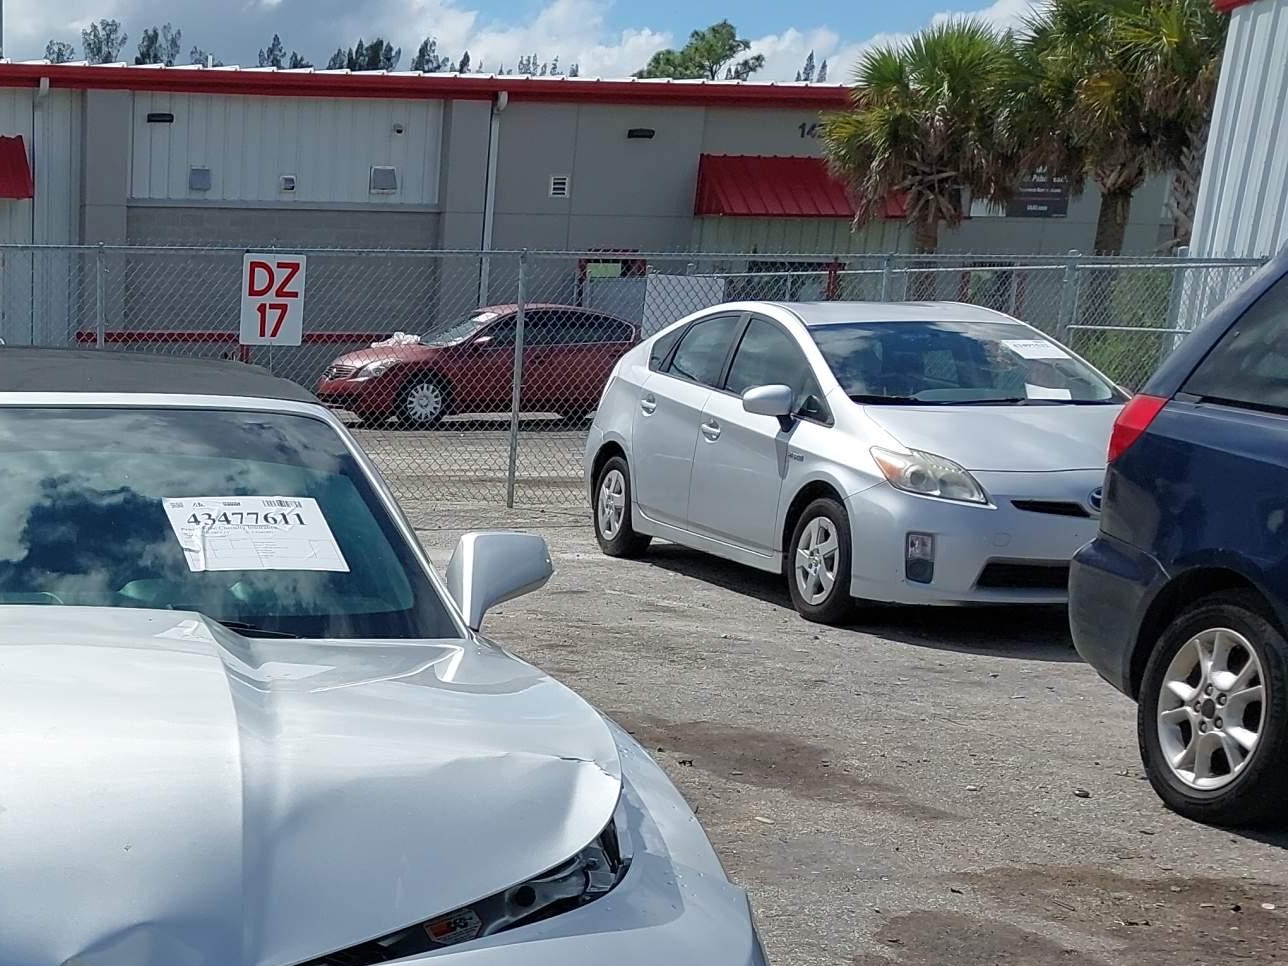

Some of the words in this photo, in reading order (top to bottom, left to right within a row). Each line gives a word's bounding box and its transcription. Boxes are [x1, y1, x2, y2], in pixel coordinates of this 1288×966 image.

[248, 261, 301, 298] DZ
[257, 303, 289, 337] 17
[186, 511, 308, 526] 43477611
